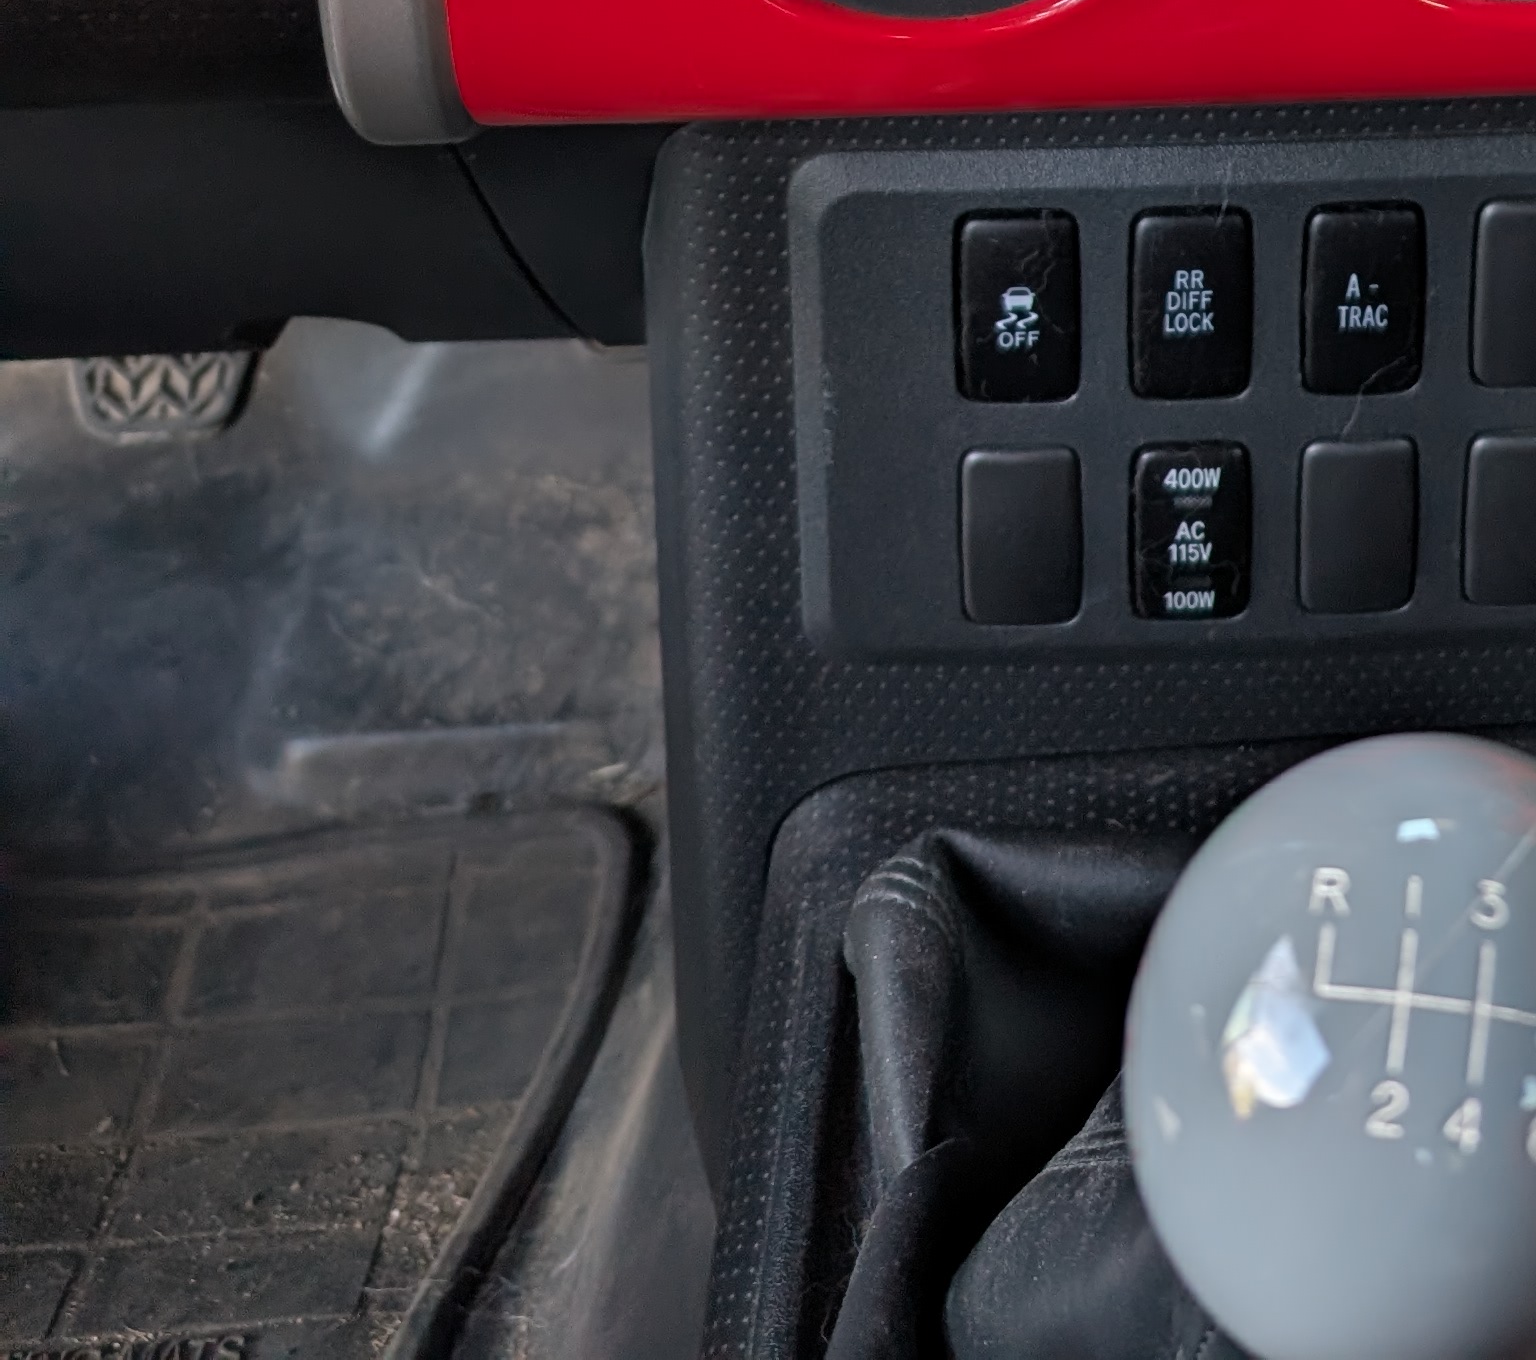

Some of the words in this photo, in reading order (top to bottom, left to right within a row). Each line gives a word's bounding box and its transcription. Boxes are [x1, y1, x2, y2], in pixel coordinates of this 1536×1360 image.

[1174, 269, 1204, 290] RR
[1165, 290, 1213, 311] DIFF
[1164, 311, 1215, 333] LOCK
[1337, 304, 1389, 328] TRAC
[998, 330, 1040, 348] OFF
[1163, 467, 1221, 489] 400W
[1175, 521, 1206, 541] AC
[1168, 542, 1212, 563] 115V
[1163, 591, 1215, 610] 100W
[1308, 866, 1351, 916] R
[1365, 1079, 1410, 1139] 2
[1443, 1097, 1483, 1156] 4
